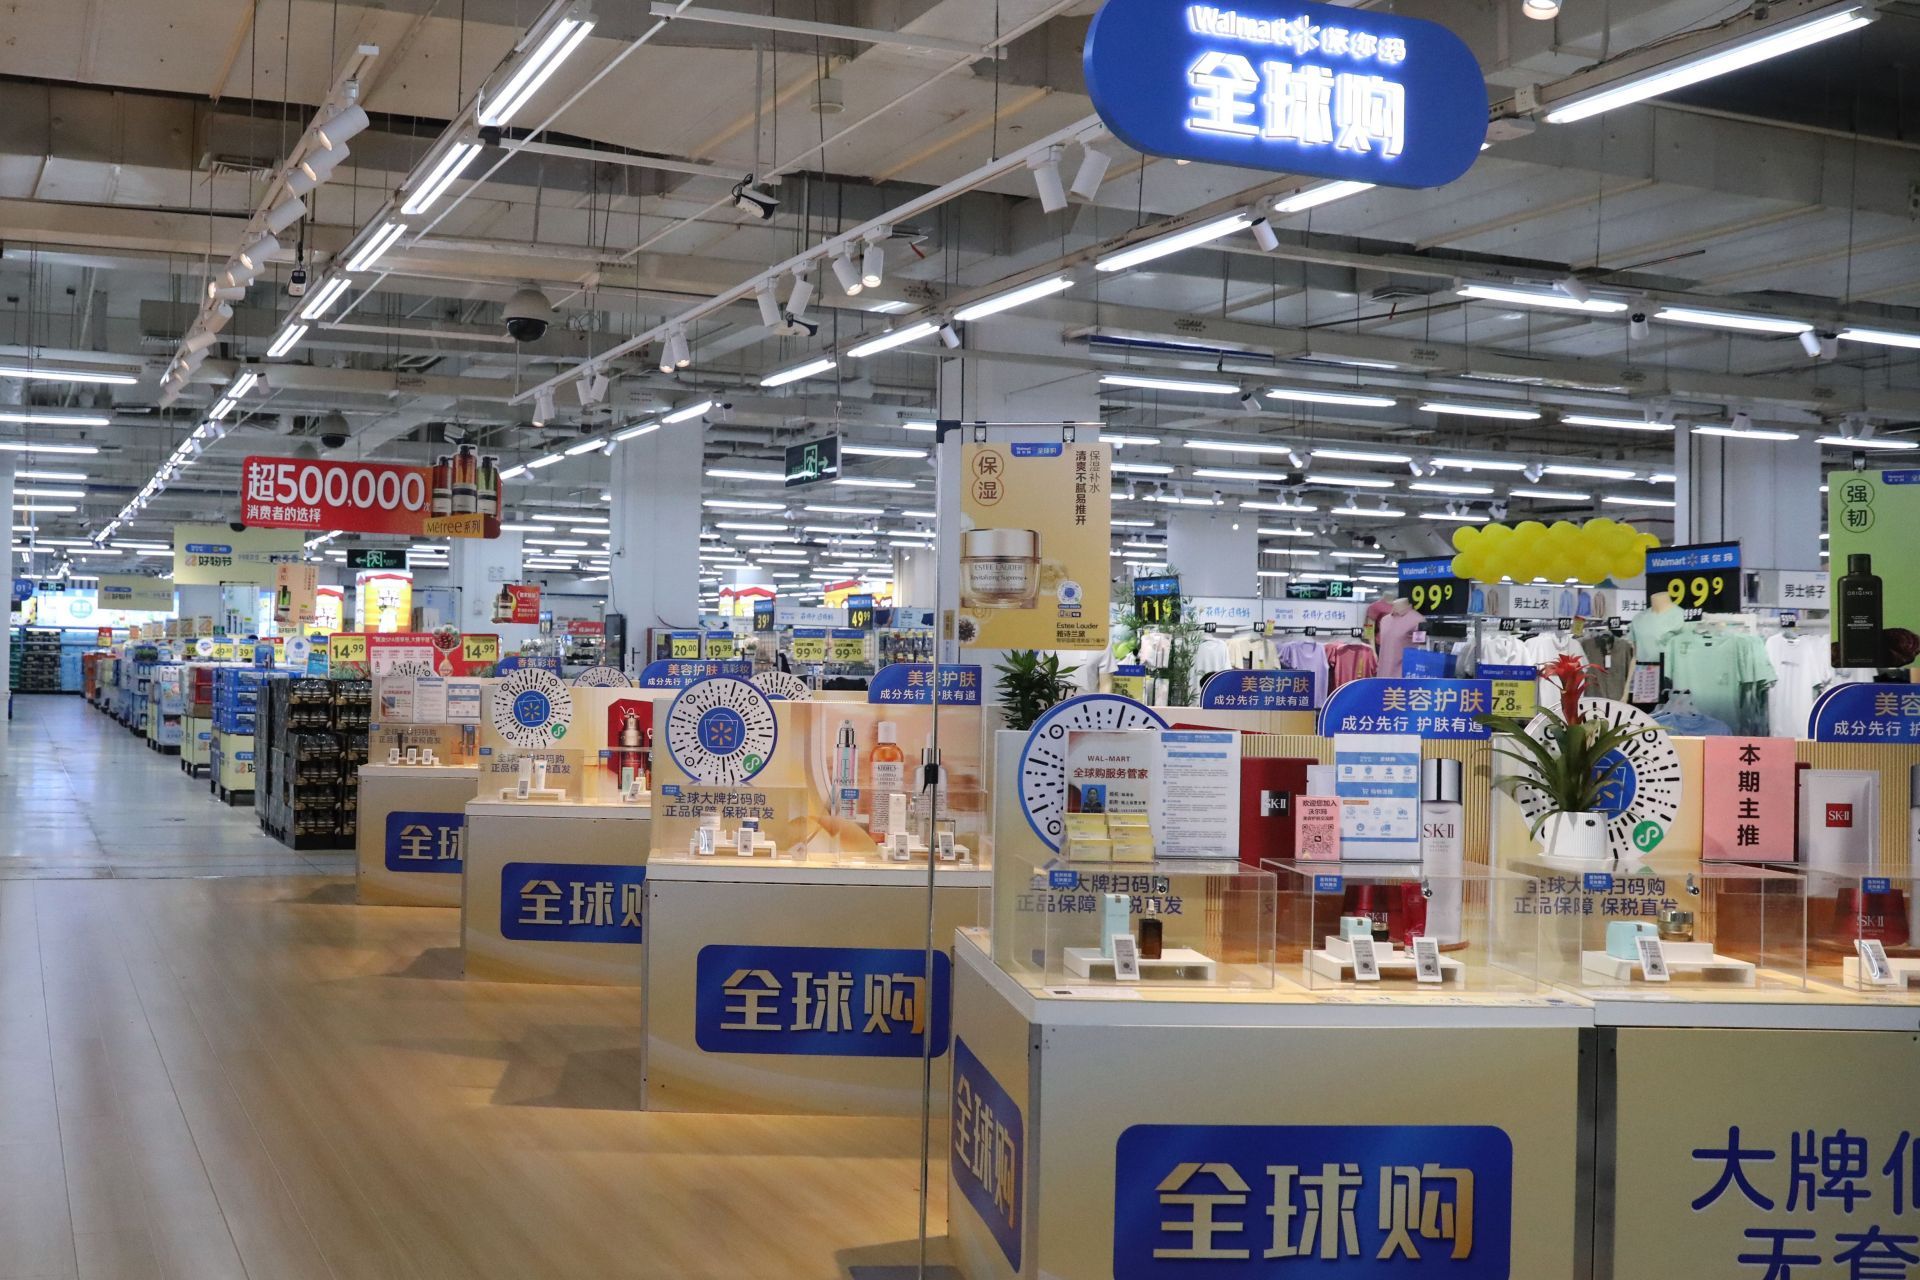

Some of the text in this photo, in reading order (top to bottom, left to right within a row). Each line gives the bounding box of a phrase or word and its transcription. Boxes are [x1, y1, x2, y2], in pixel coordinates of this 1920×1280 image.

[1188, 5, 1406, 64] Walmart 沃尔玛
[1187, 50, 1405, 157] 全球购
[978, 456, 998, 500] 保湿
[1089, 450, 1101, 494] 保湿补水
[1075, 450, 1087, 526] 清爽不腻易推开
[246, 504, 321, 523] 消费者的选择
[1847, 485, 1868, 527] 强韧
[1652, 552, 1734, 567] Walmart 沃尔玛
[1402, 566, 1428, 576] Walmart
[1784, 584, 1826, 599] 男士裤子
[1514, 597, 1549, 610] 男士上衣
[332, 643, 364, 659] 14.99
[465, 643, 495, 659] 14.99
[673, 644, 698, 656] 20.00
[796, 647, 822, 658] 99.90
[835, 648, 861, 659] 99.90
[667, 663, 718, 676] 美容护肤
[647, 677, 681, 686] 成分先行
[1241, 675, 1310, 693] 美容护肤
[880, 688, 926, 700] 成分先行
[1214, 694, 1310, 707] 成分先行 护肤有道
[1383, 686, 1485, 713] 美容护肤
[1341, 716, 1485, 733] 成分先行 护肤有道
[1834, 720, 1902, 737] 成分先行
[1073, 767, 1149, 780] 全球购服务管家
[1737, 743, 1761, 847] 本期主推
[1828, 810, 1851, 821] SK-II
[1423, 823, 1455, 839] SK-II
[1015, 893, 1097, 914] 正品保障
[1514, 896, 1594, 916] 正品保障
[719, 968, 926, 1035] 全球购
[955, 1071, 1017, 1231] 全球购
[1153, 1162, 1475, 1260] 全球购
